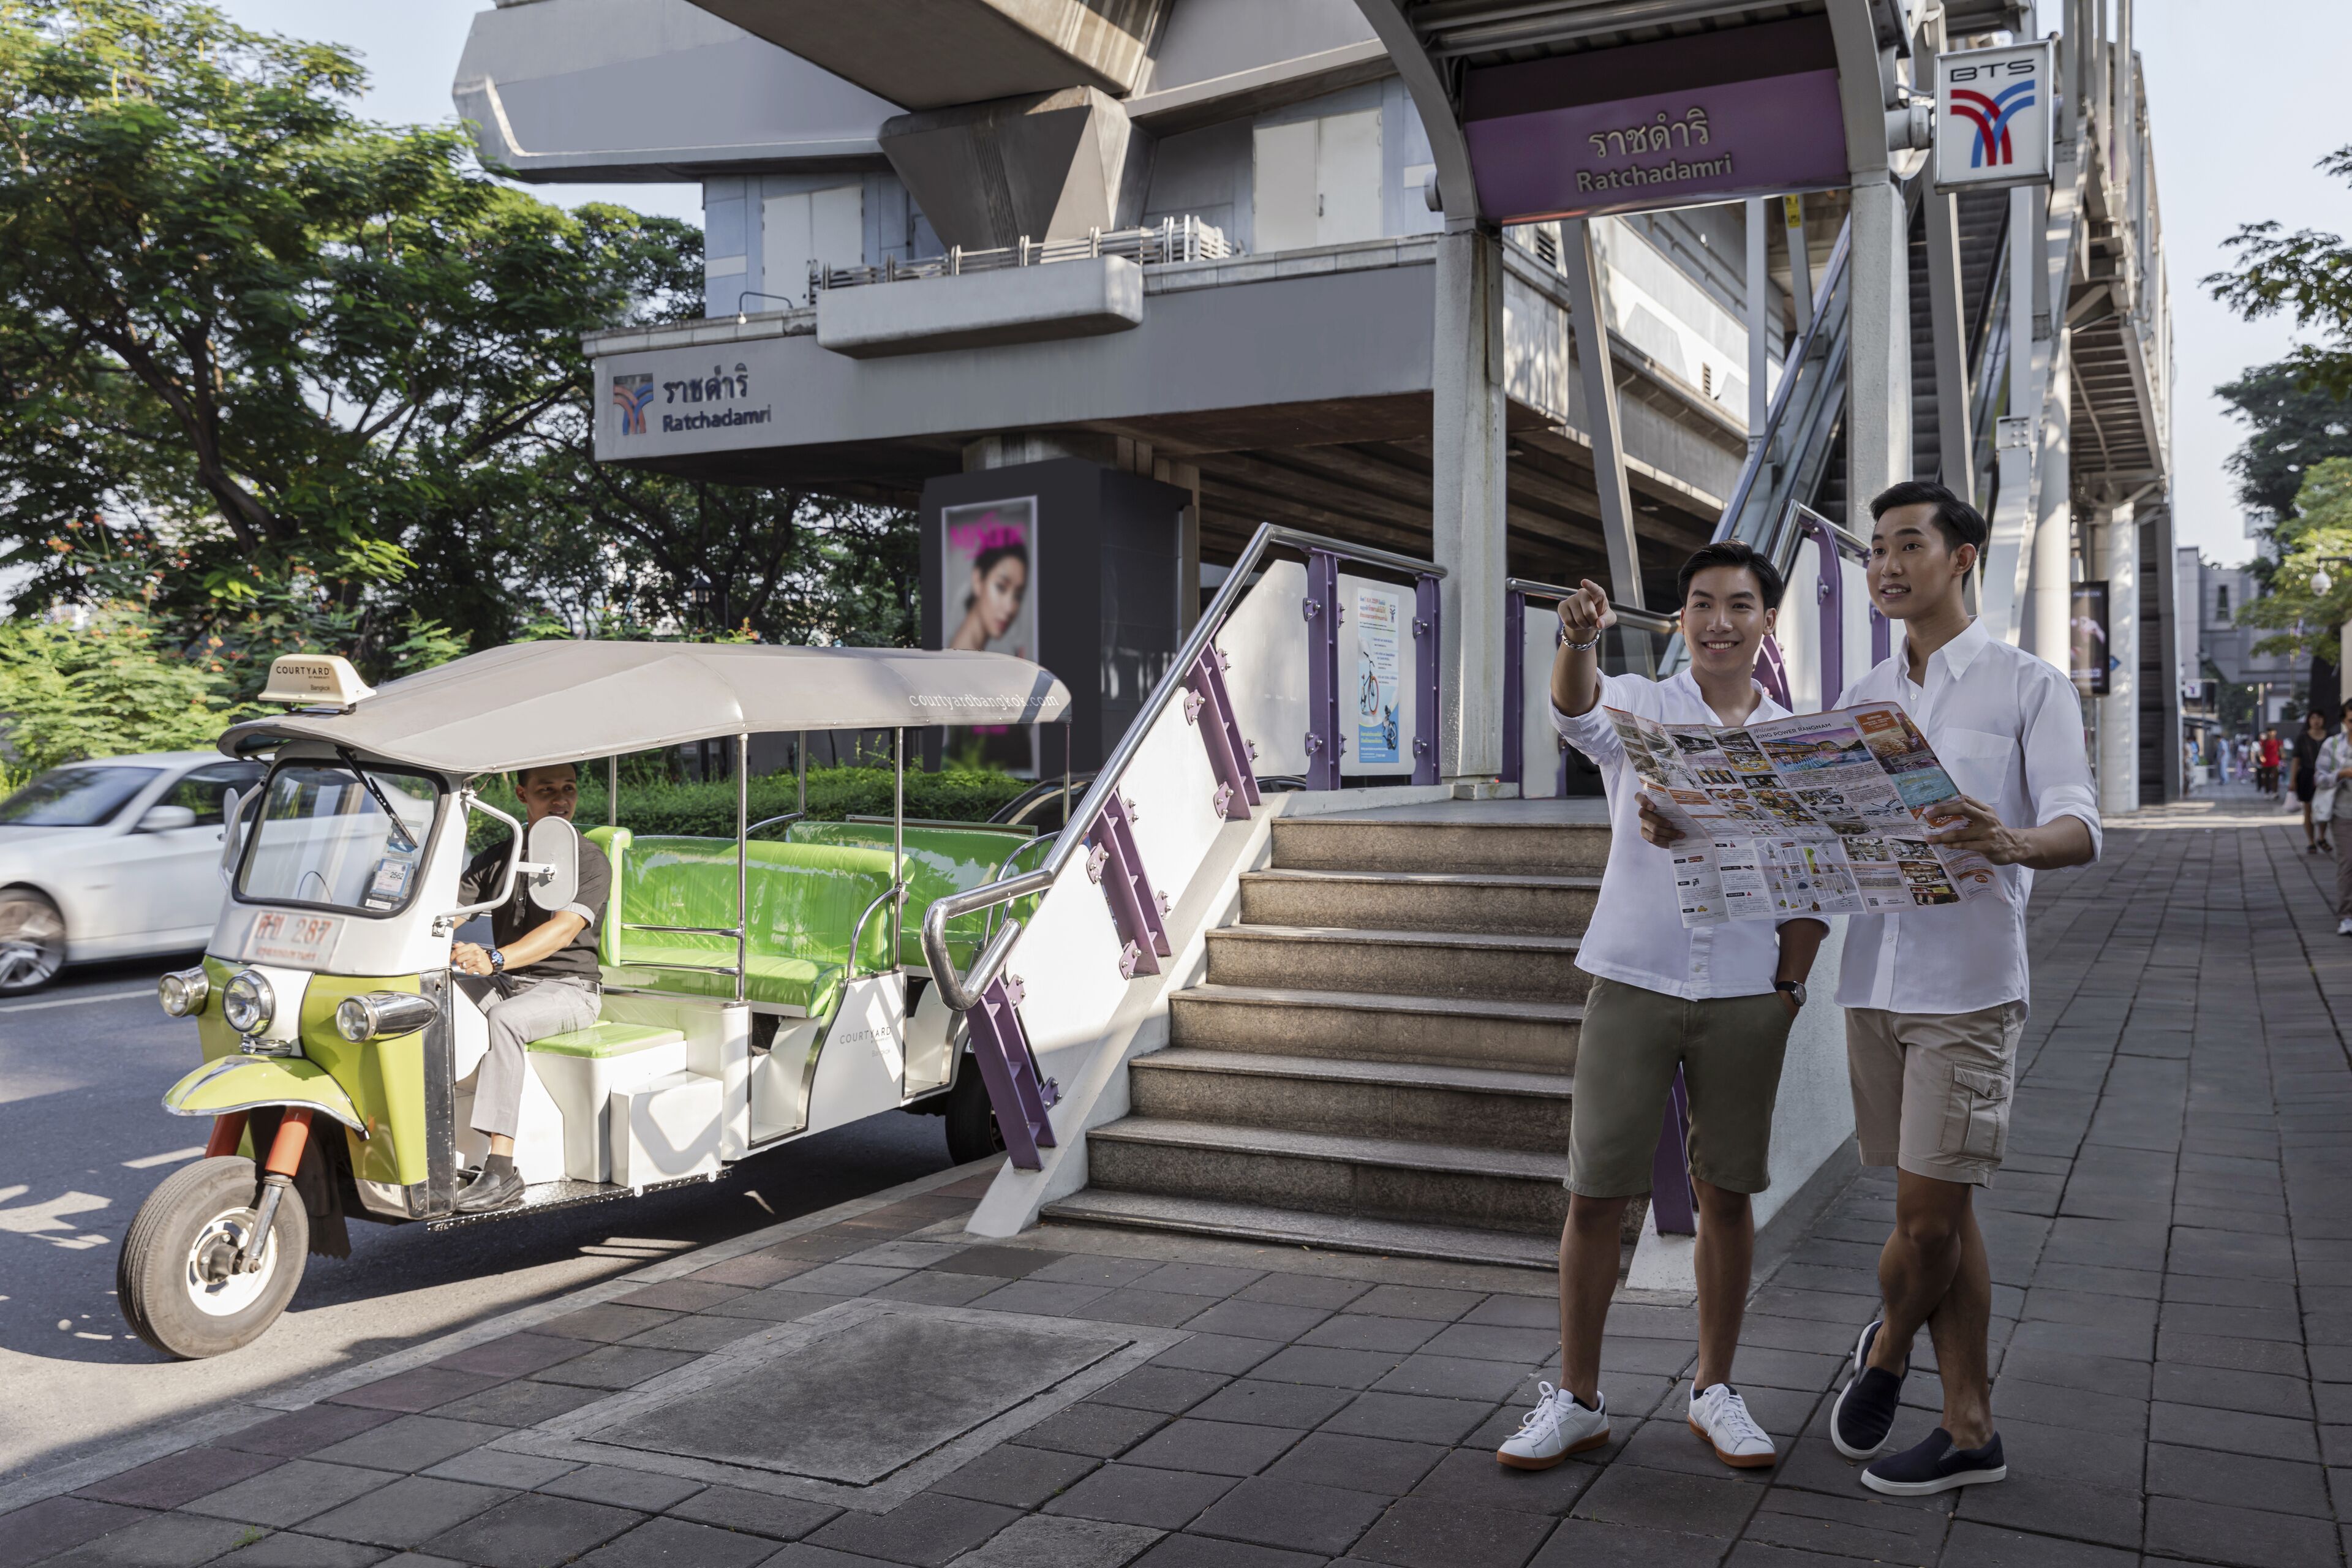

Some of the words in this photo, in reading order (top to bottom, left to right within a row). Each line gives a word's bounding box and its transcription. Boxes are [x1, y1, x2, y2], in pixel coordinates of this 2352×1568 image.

[1950, 58, 2035, 83] BTS
[1588, 107, 1709, 158] ราชดำริ
[1576, 154, 1732, 193] Ratchadamri
[663, 404, 771, 432] Ratchadamri
[276, 666, 330, 676] COURTYARD
[909, 694, 1060, 710] courtyardbangkok.com
[1753, 725, 1779, 734] Welcome
[1773, 728, 1796, 737] POWER
[1798, 723, 1831, 733] RANGNAM
[292, 916, 333, 944] 287
[840, 1027, 892, 1044] COURTYARD
